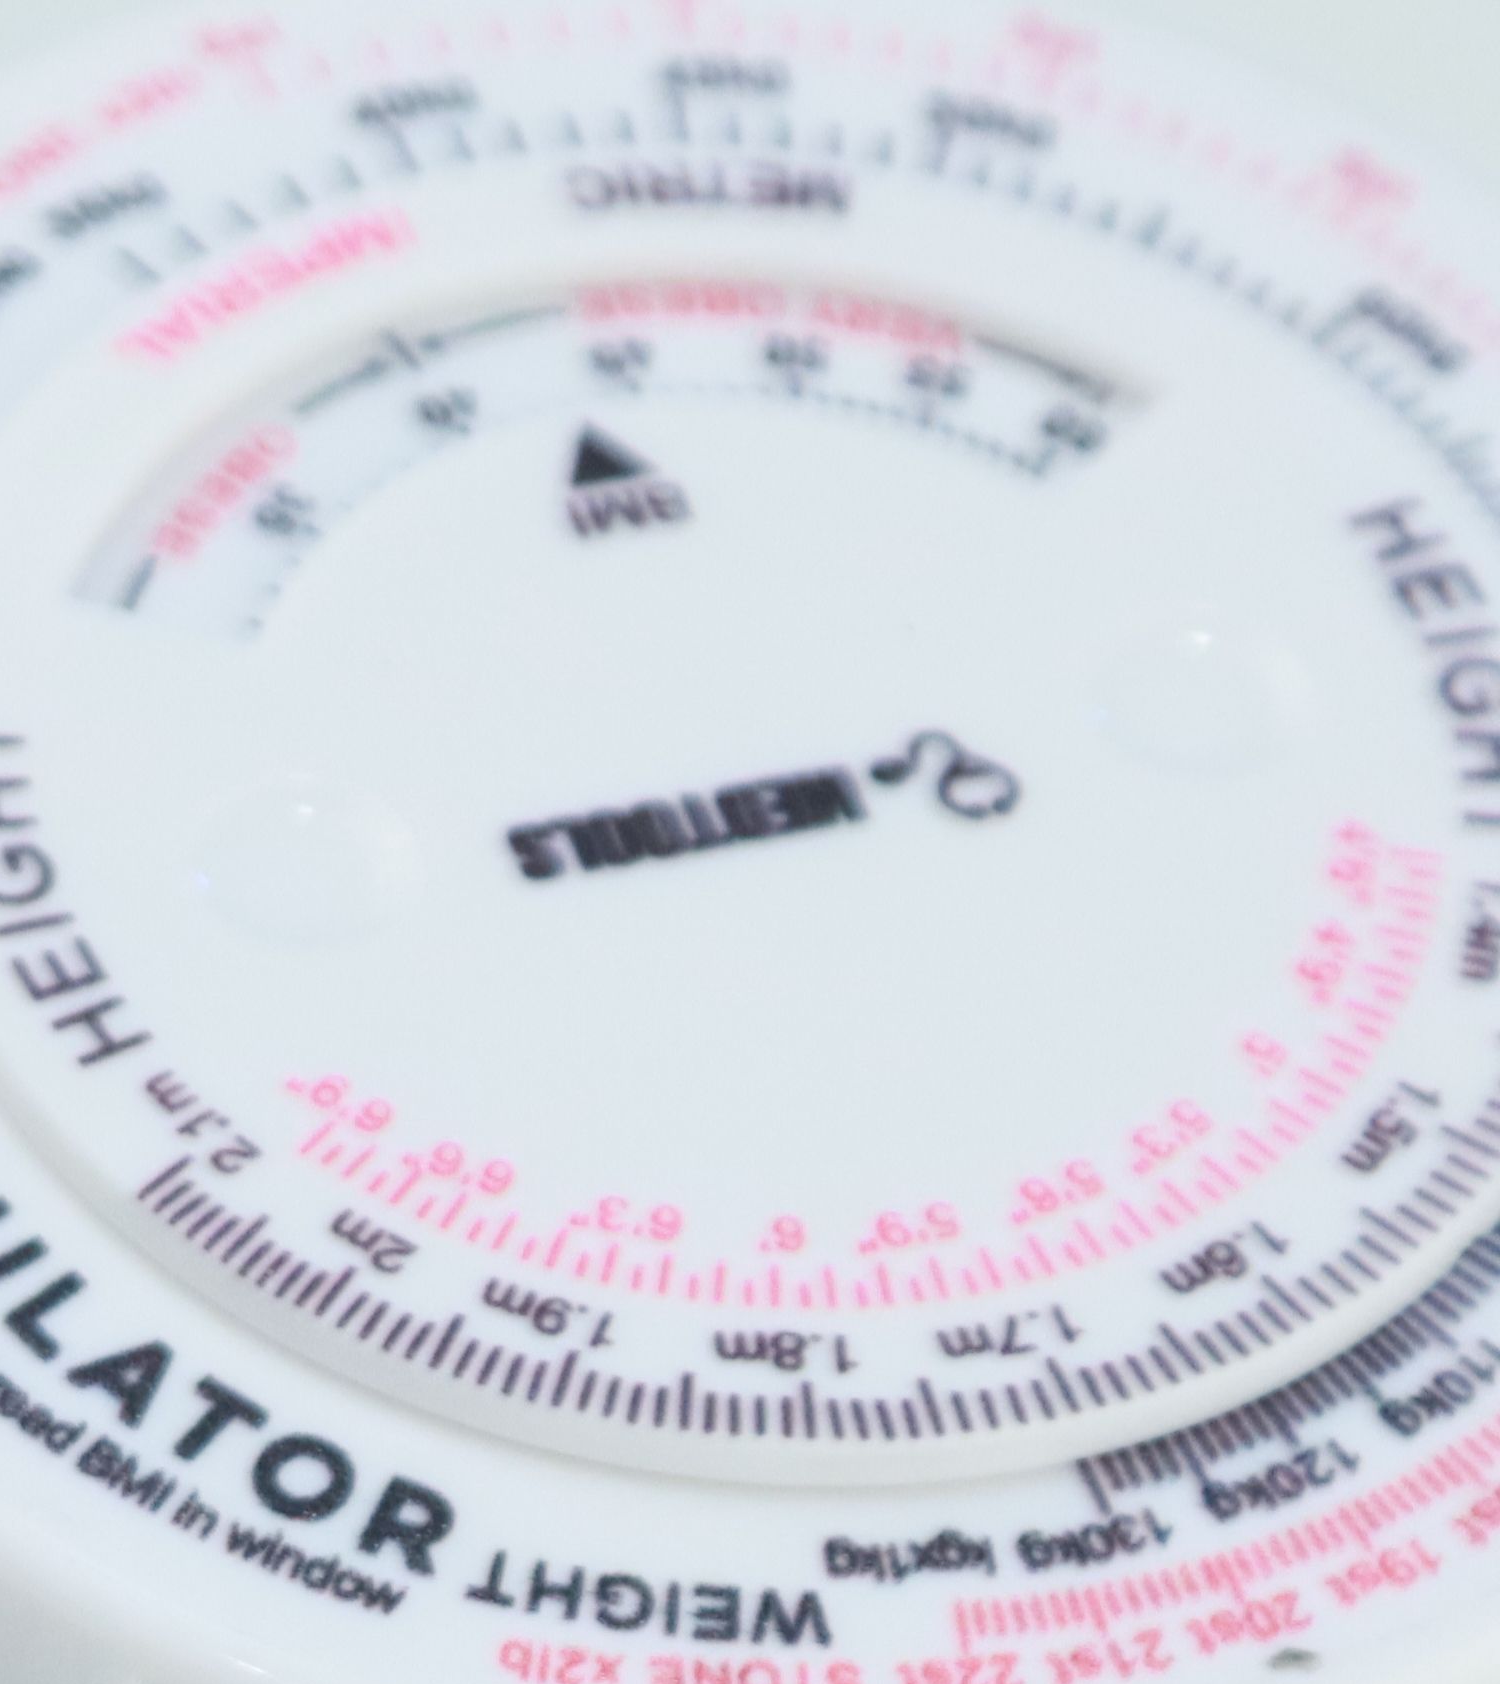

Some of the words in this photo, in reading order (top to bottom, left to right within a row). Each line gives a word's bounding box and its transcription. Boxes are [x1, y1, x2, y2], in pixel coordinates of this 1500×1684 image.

[566, 164, 850, 214] METRIC
[146, 1071, 260, 1173] 2.1m
[1342, 1081, 1440, 1172] 1.5m
[331, 1209, 417, 1273] 2m
[1160, 1220, 1287, 1293] 1.6m
[482, 1278, 613, 1348] 1.9m
[936, 1305, 1080, 1356] 1.7m
[715, 1331, 856, 1373] 1.8m
[1201, 1438, 1360, 1520] 120kg
[77, 1437, 175, 1511] BMI
[170, 1494, 219, 1538] in
[226, 1522, 407, 1613] window
[1016, 1508, 1172, 1571] 130kg
[466, 1550, 832, 1647] WEIGHT
[1187, 1591, 1311, 1656] 20st
